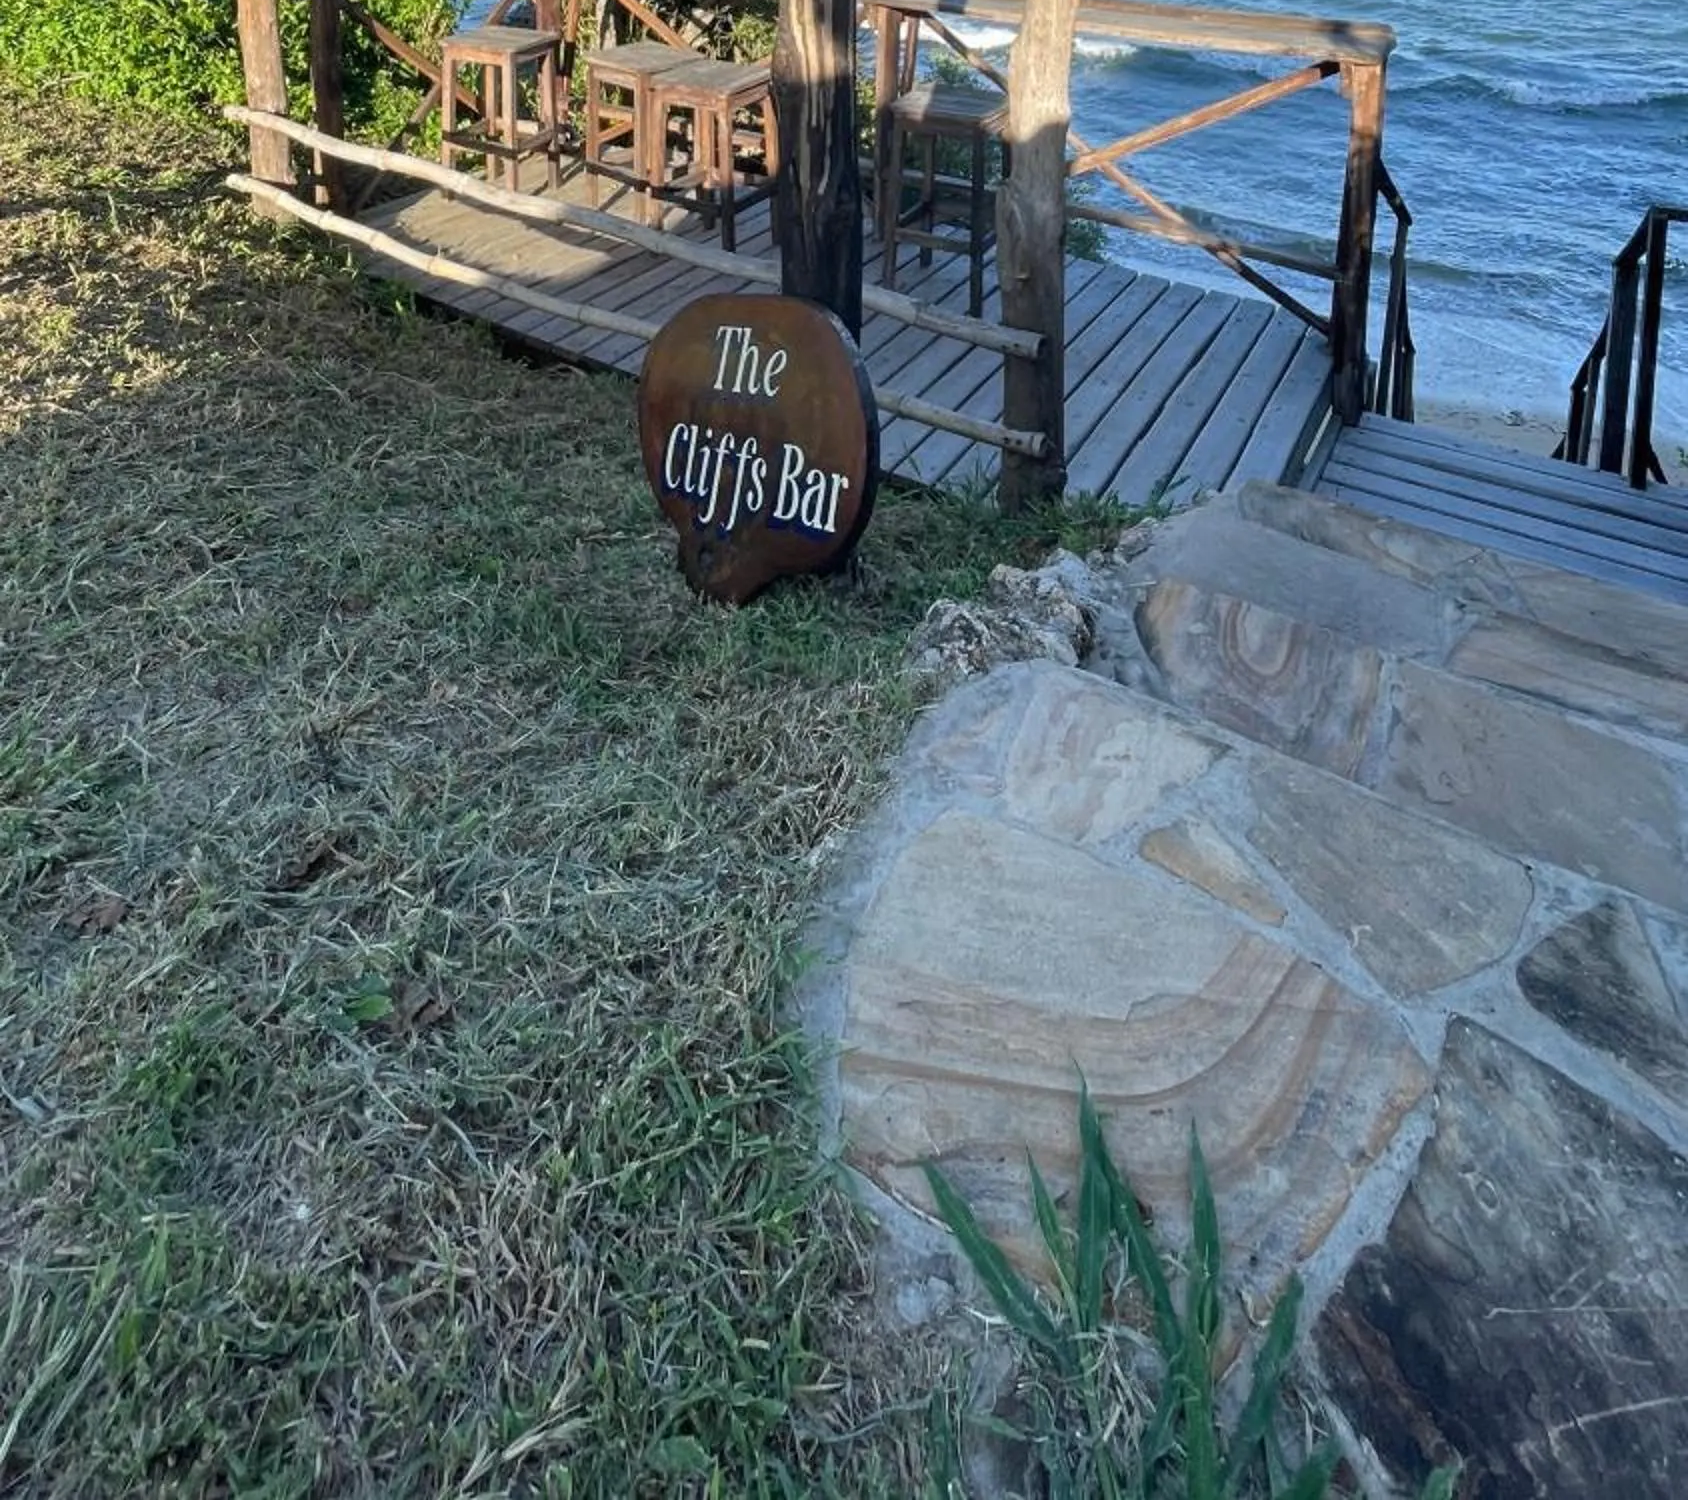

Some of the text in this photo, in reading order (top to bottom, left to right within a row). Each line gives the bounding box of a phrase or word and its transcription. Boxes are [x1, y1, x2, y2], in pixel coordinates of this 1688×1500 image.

[713, 325, 788, 397] The
[664, 422, 849, 533] Cliffs Bar
